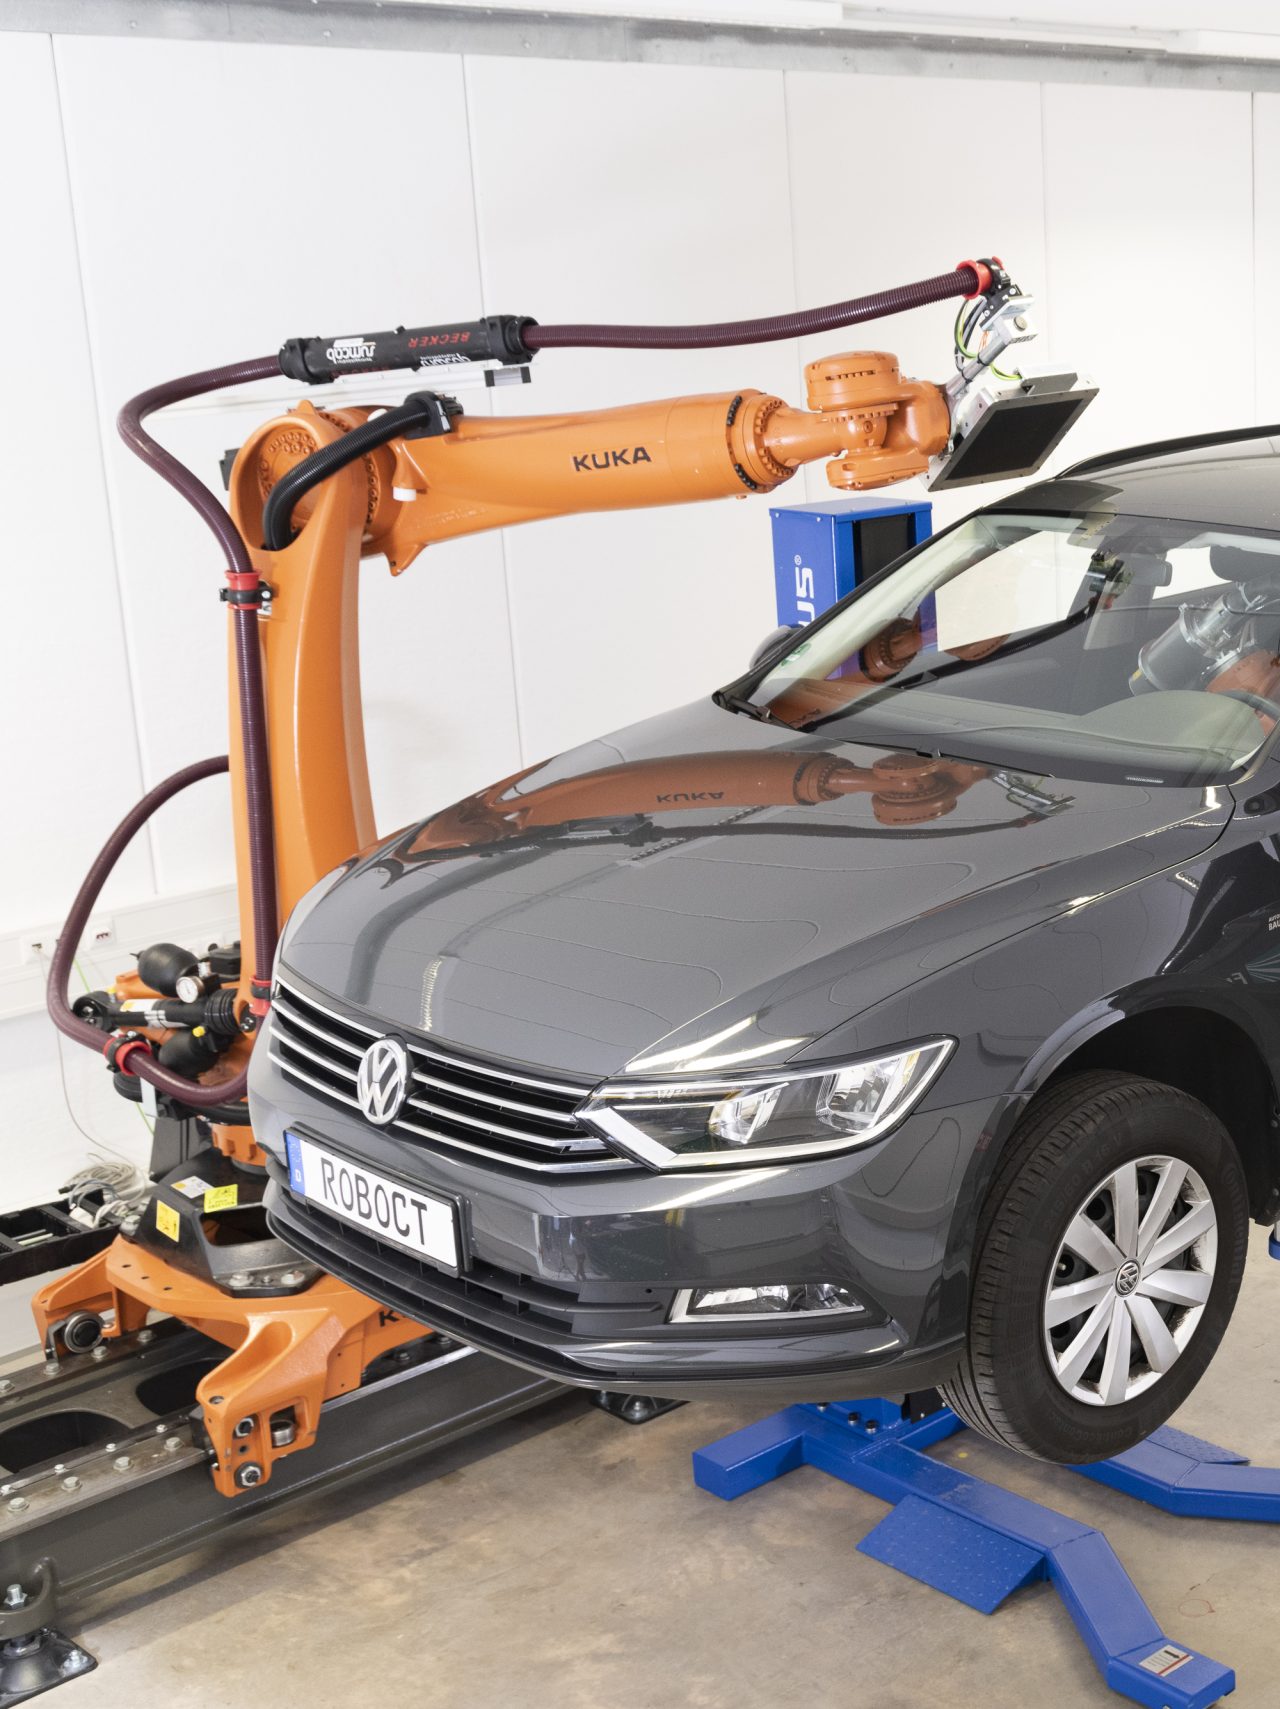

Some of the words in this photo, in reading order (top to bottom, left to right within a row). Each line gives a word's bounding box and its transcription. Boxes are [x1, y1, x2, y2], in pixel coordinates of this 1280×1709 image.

[408, 331, 472, 348] BECKER
[326, 344, 376, 365] sumcab
[572, 446, 652, 472] KUKA
[294, 1169, 302, 1183] D
[320, 1156, 428, 1246] ROBOCT
